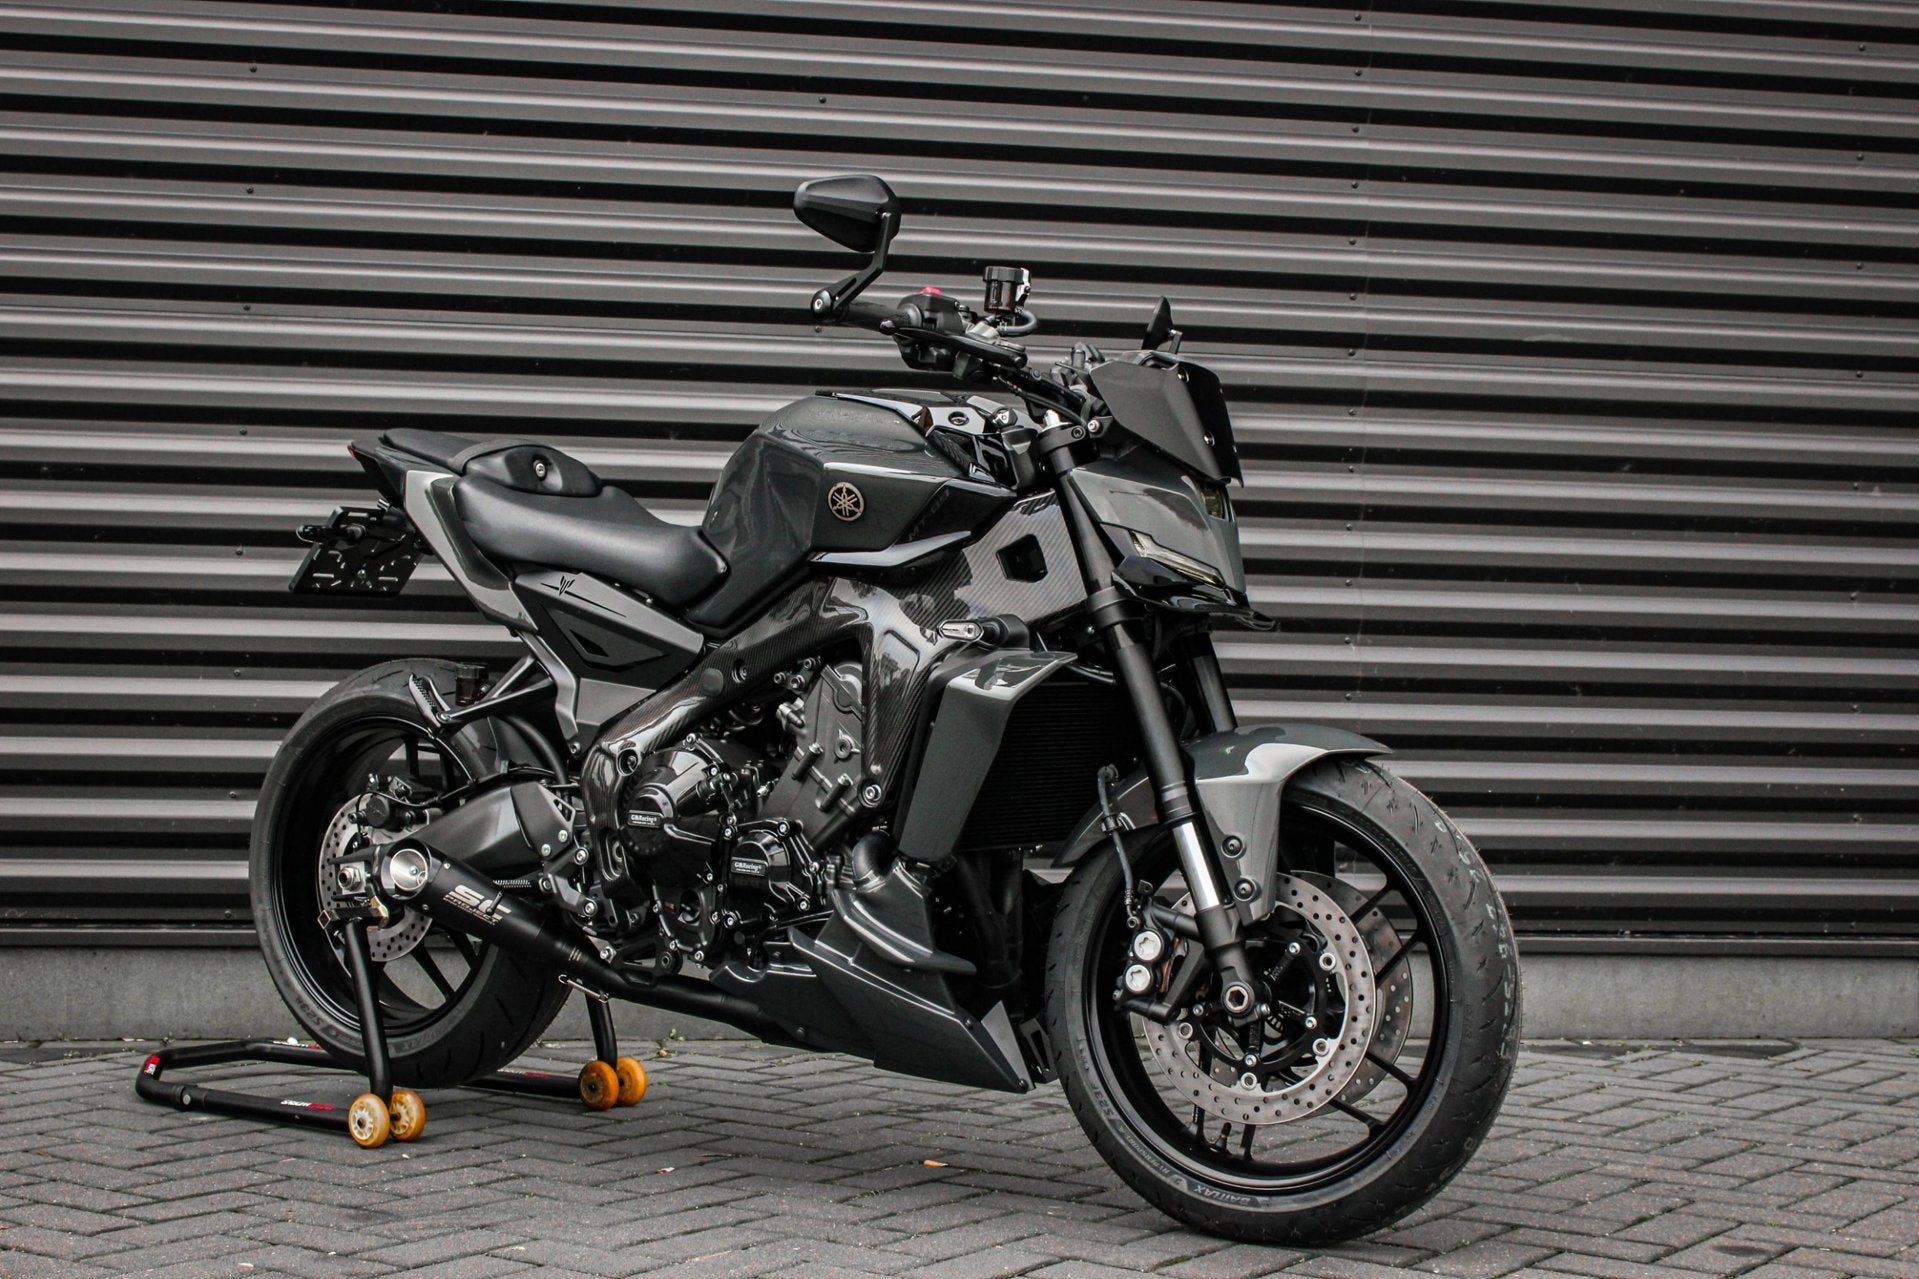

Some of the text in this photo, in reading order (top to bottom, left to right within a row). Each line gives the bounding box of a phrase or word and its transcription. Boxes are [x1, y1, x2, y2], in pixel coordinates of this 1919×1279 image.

[443, 894, 499, 924] PROJECT
[444, 884, 512, 920] SC
[1193, 1183, 1251, 1205] BATTLAX
